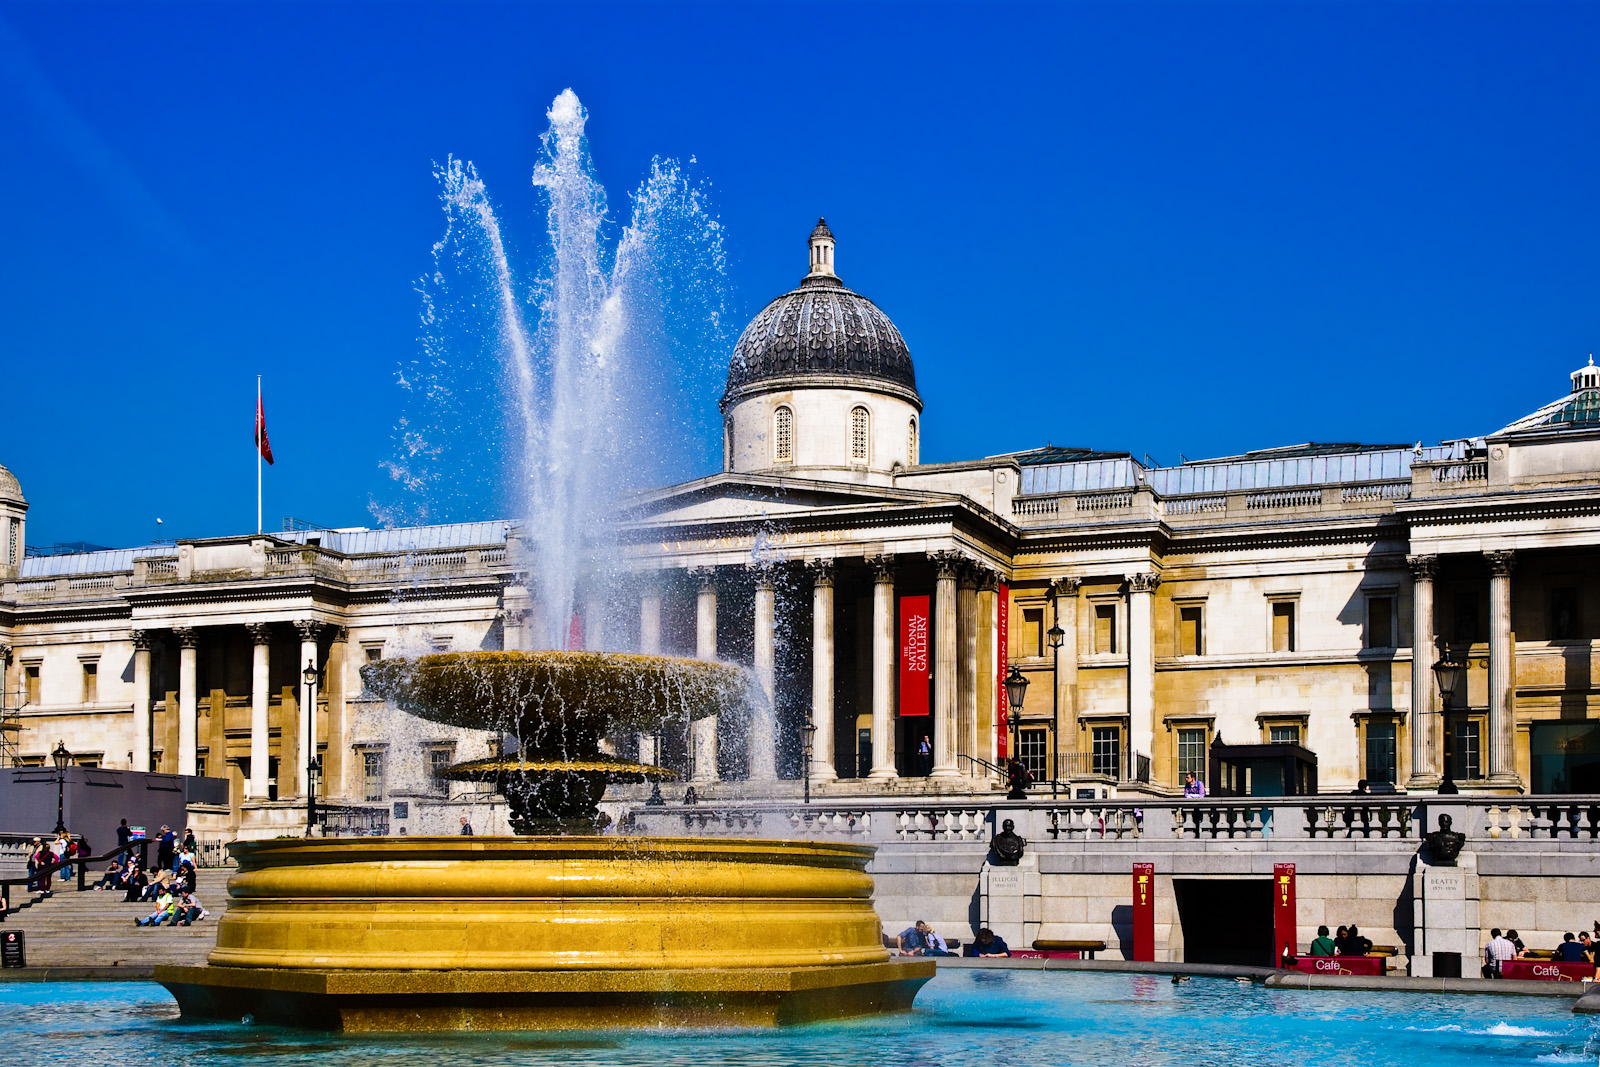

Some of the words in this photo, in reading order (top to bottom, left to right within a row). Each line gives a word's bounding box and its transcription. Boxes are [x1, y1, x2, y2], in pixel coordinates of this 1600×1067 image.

[661, 537, 755, 551] NATIONAL
[767, 528, 855, 544] GALLERY
[908, 615, 917, 671] NATIONAL
[916, 615, 927, 671] GALLERY
[1315, 959, 1341, 970] Café
[1532, 964, 1560, 976] Café
